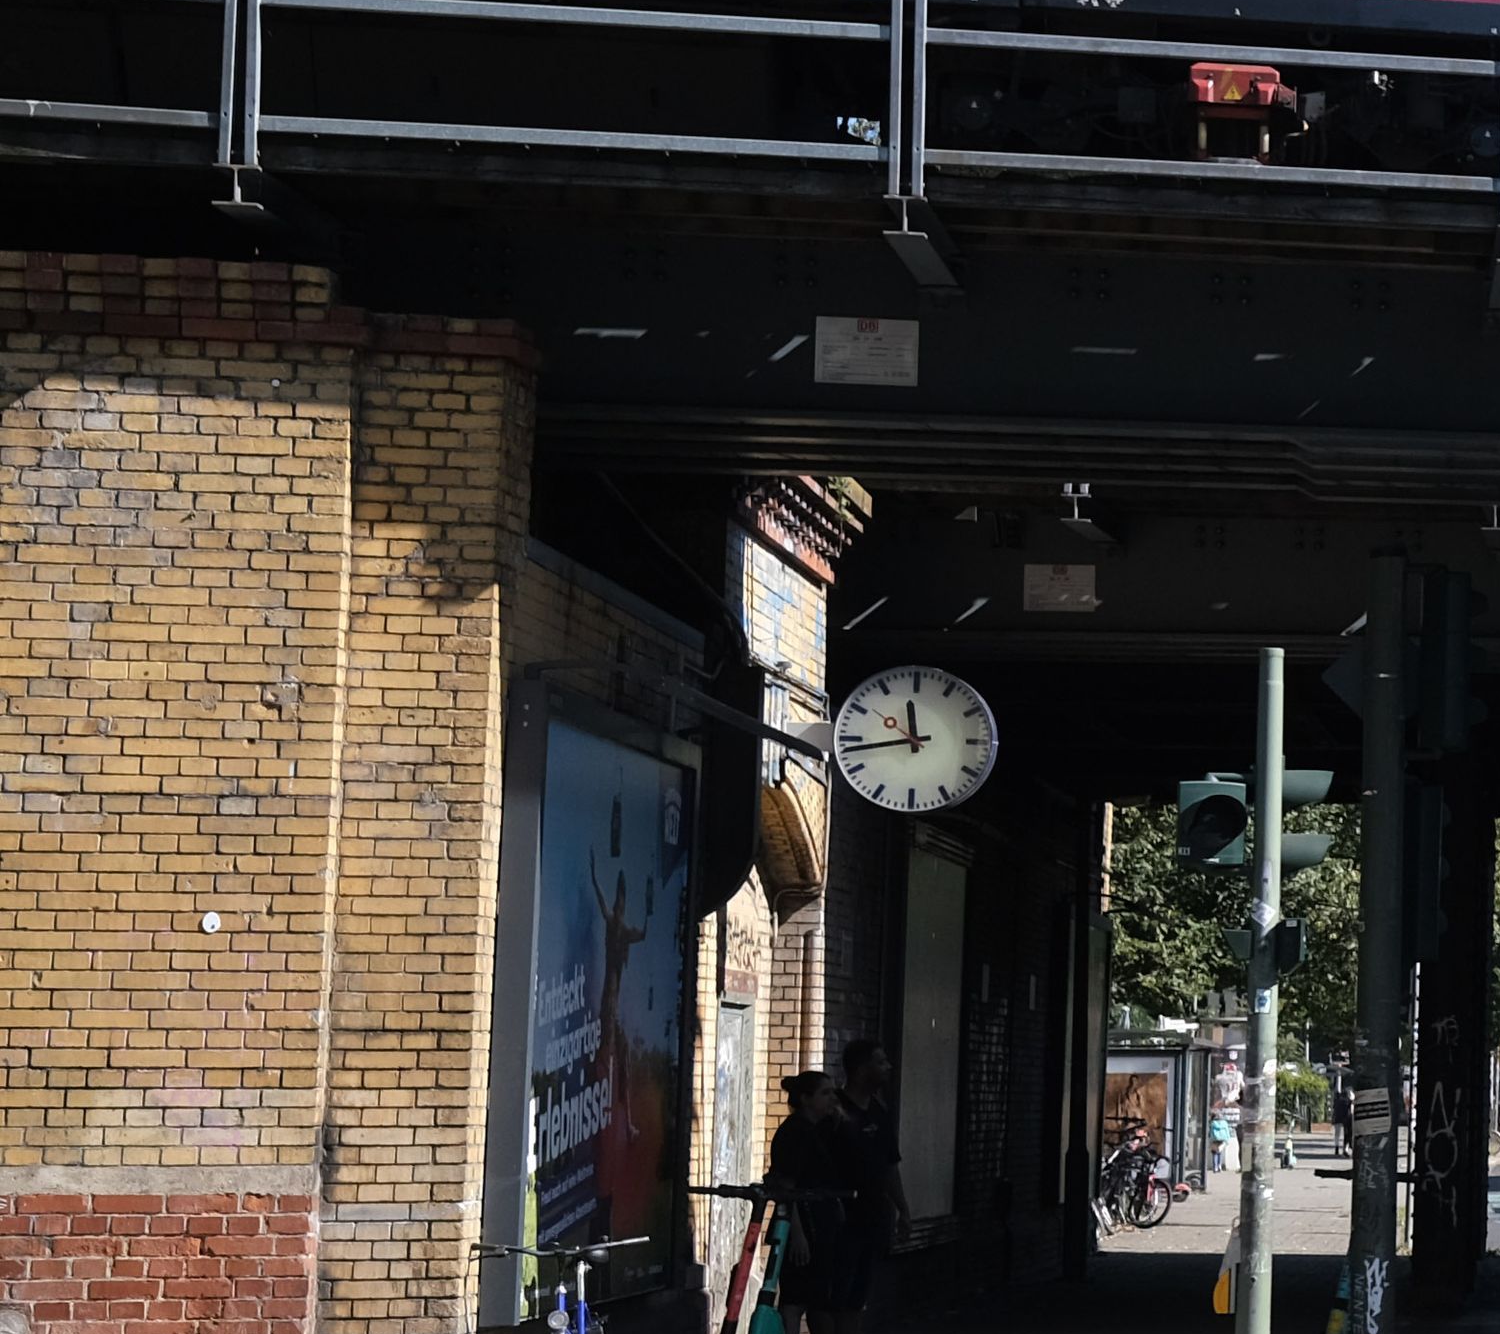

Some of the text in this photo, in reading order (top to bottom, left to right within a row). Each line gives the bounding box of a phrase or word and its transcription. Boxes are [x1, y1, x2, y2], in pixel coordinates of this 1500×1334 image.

[537, 963, 586, 1028] Entdeckt
[545, 1011, 601, 1076] einzigartige
[527, 1055, 614, 1175] Erlebnisse!
